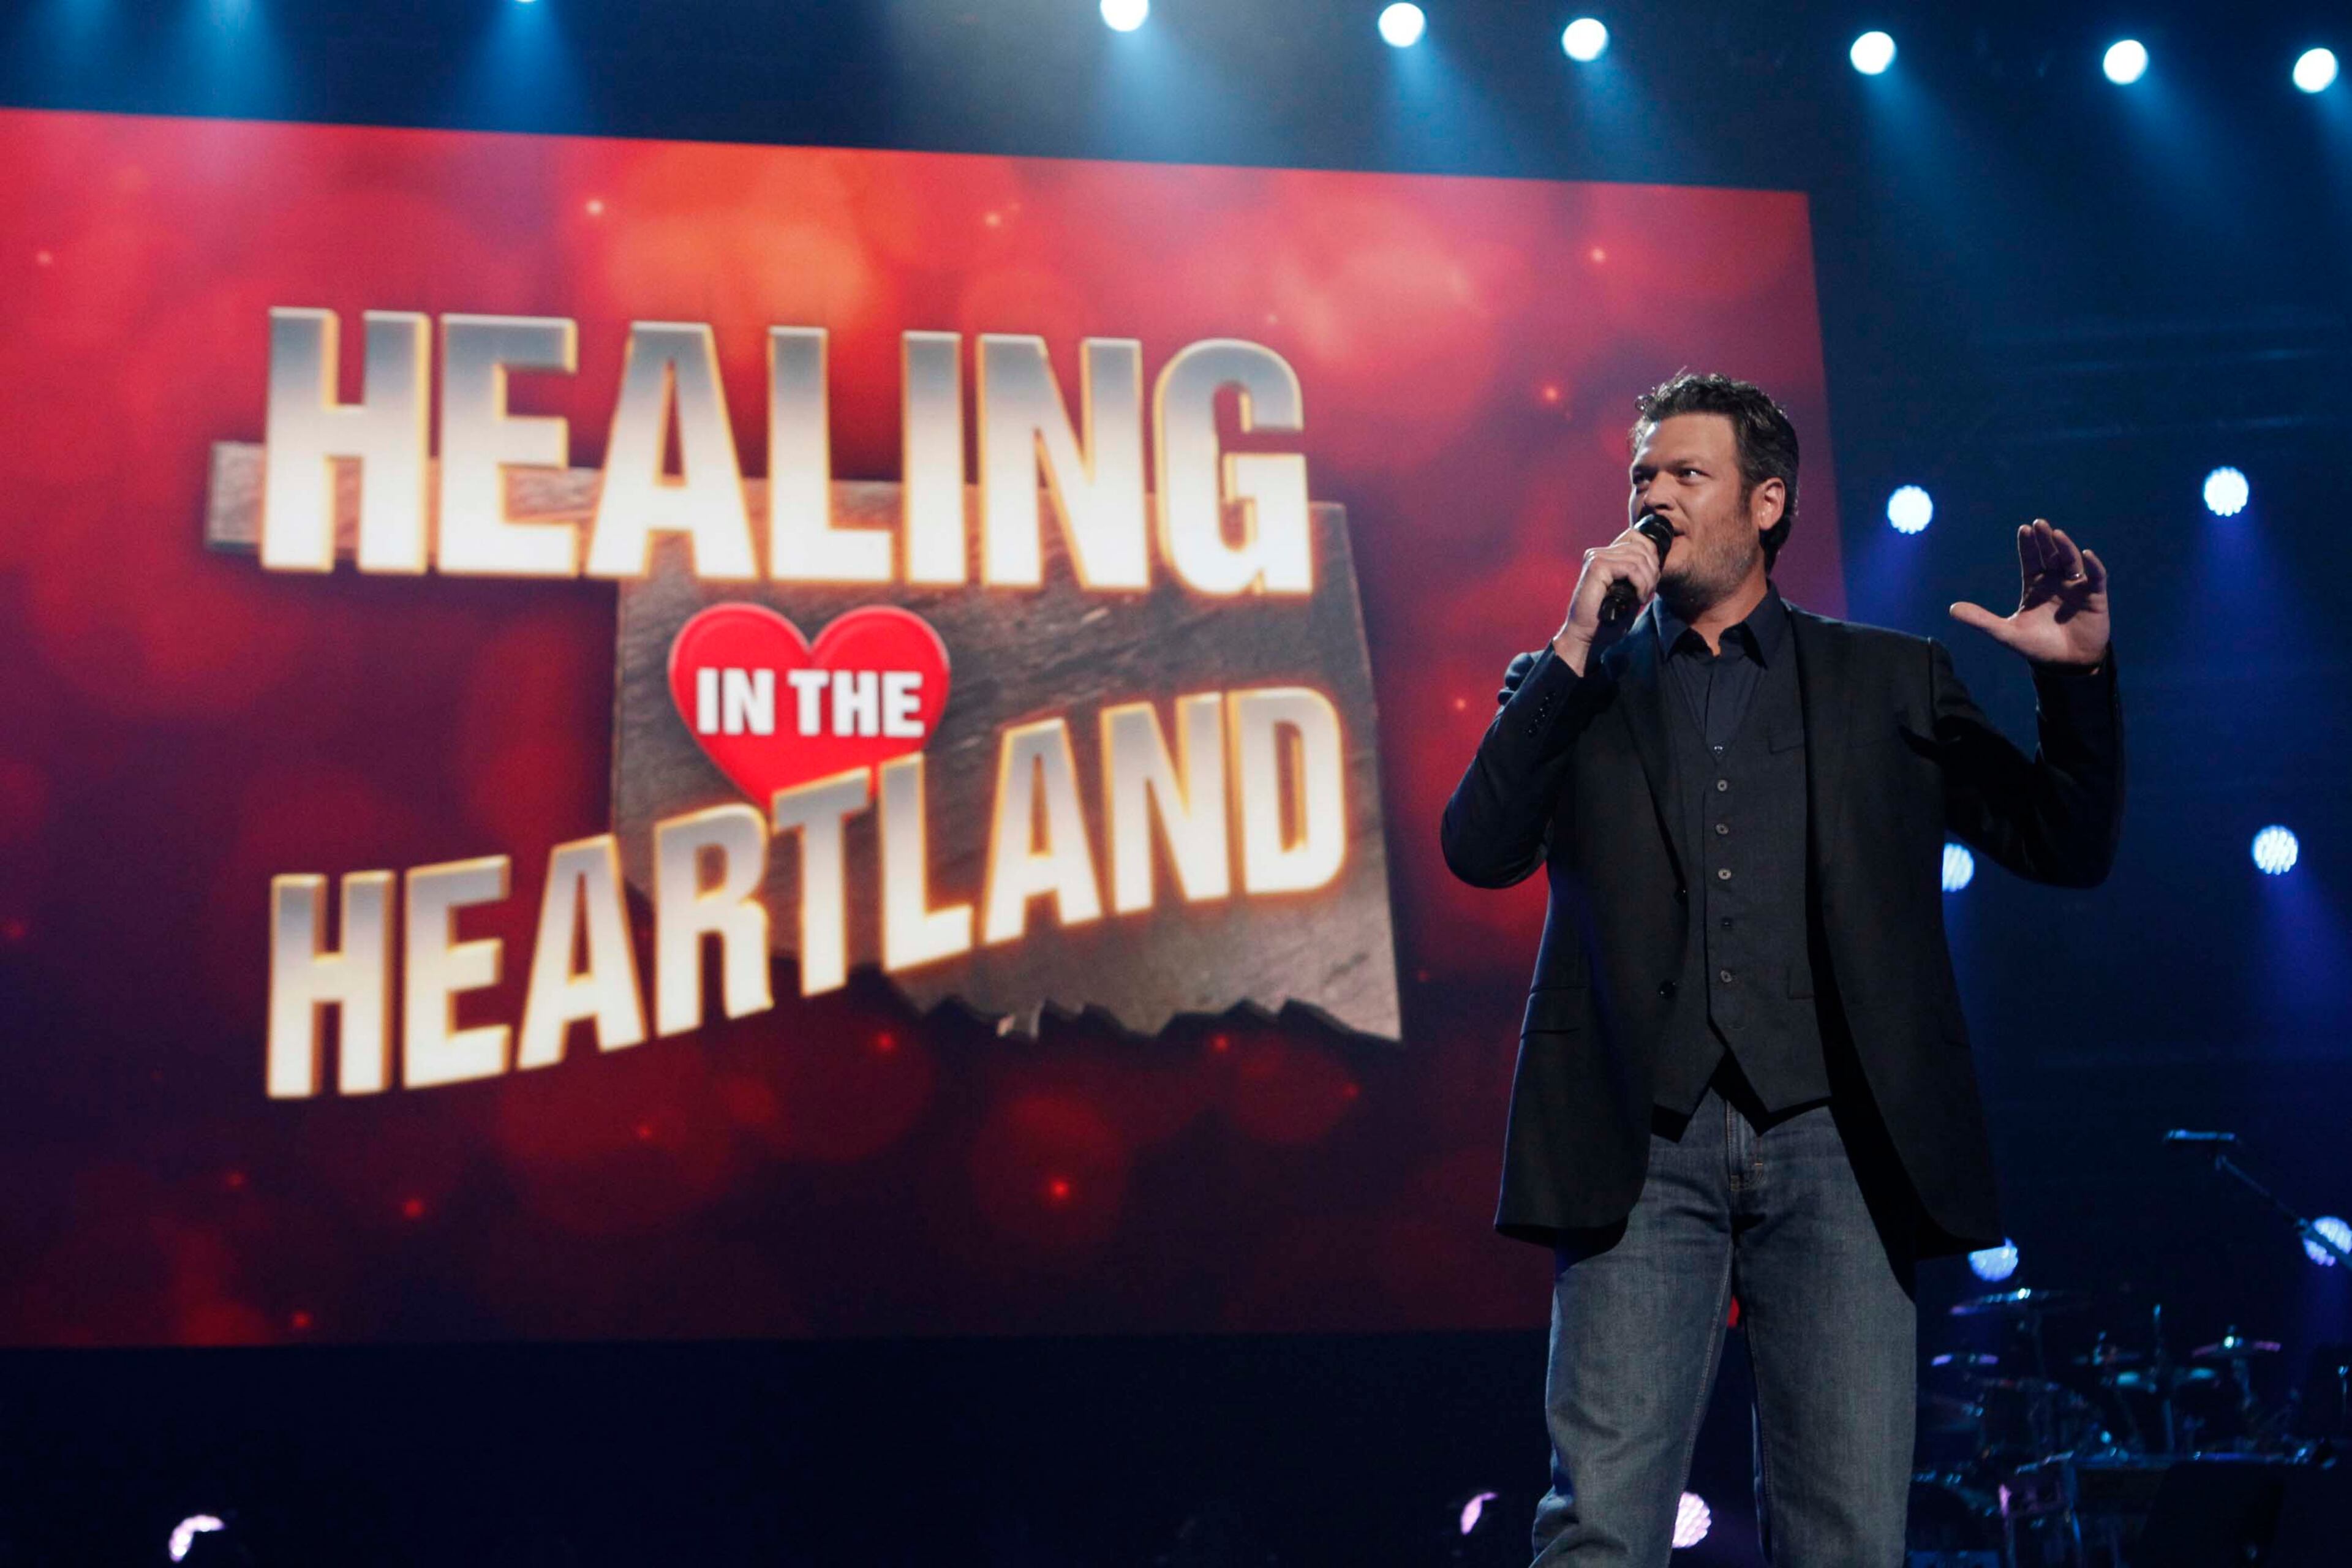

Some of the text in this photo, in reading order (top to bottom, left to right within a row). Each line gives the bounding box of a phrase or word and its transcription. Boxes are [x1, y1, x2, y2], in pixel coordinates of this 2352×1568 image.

[261, 307, 1314, 595] HEALING
[696, 667, 925, 738] IN THE
[265, 686, 1348, 1100] HEARTLAND
